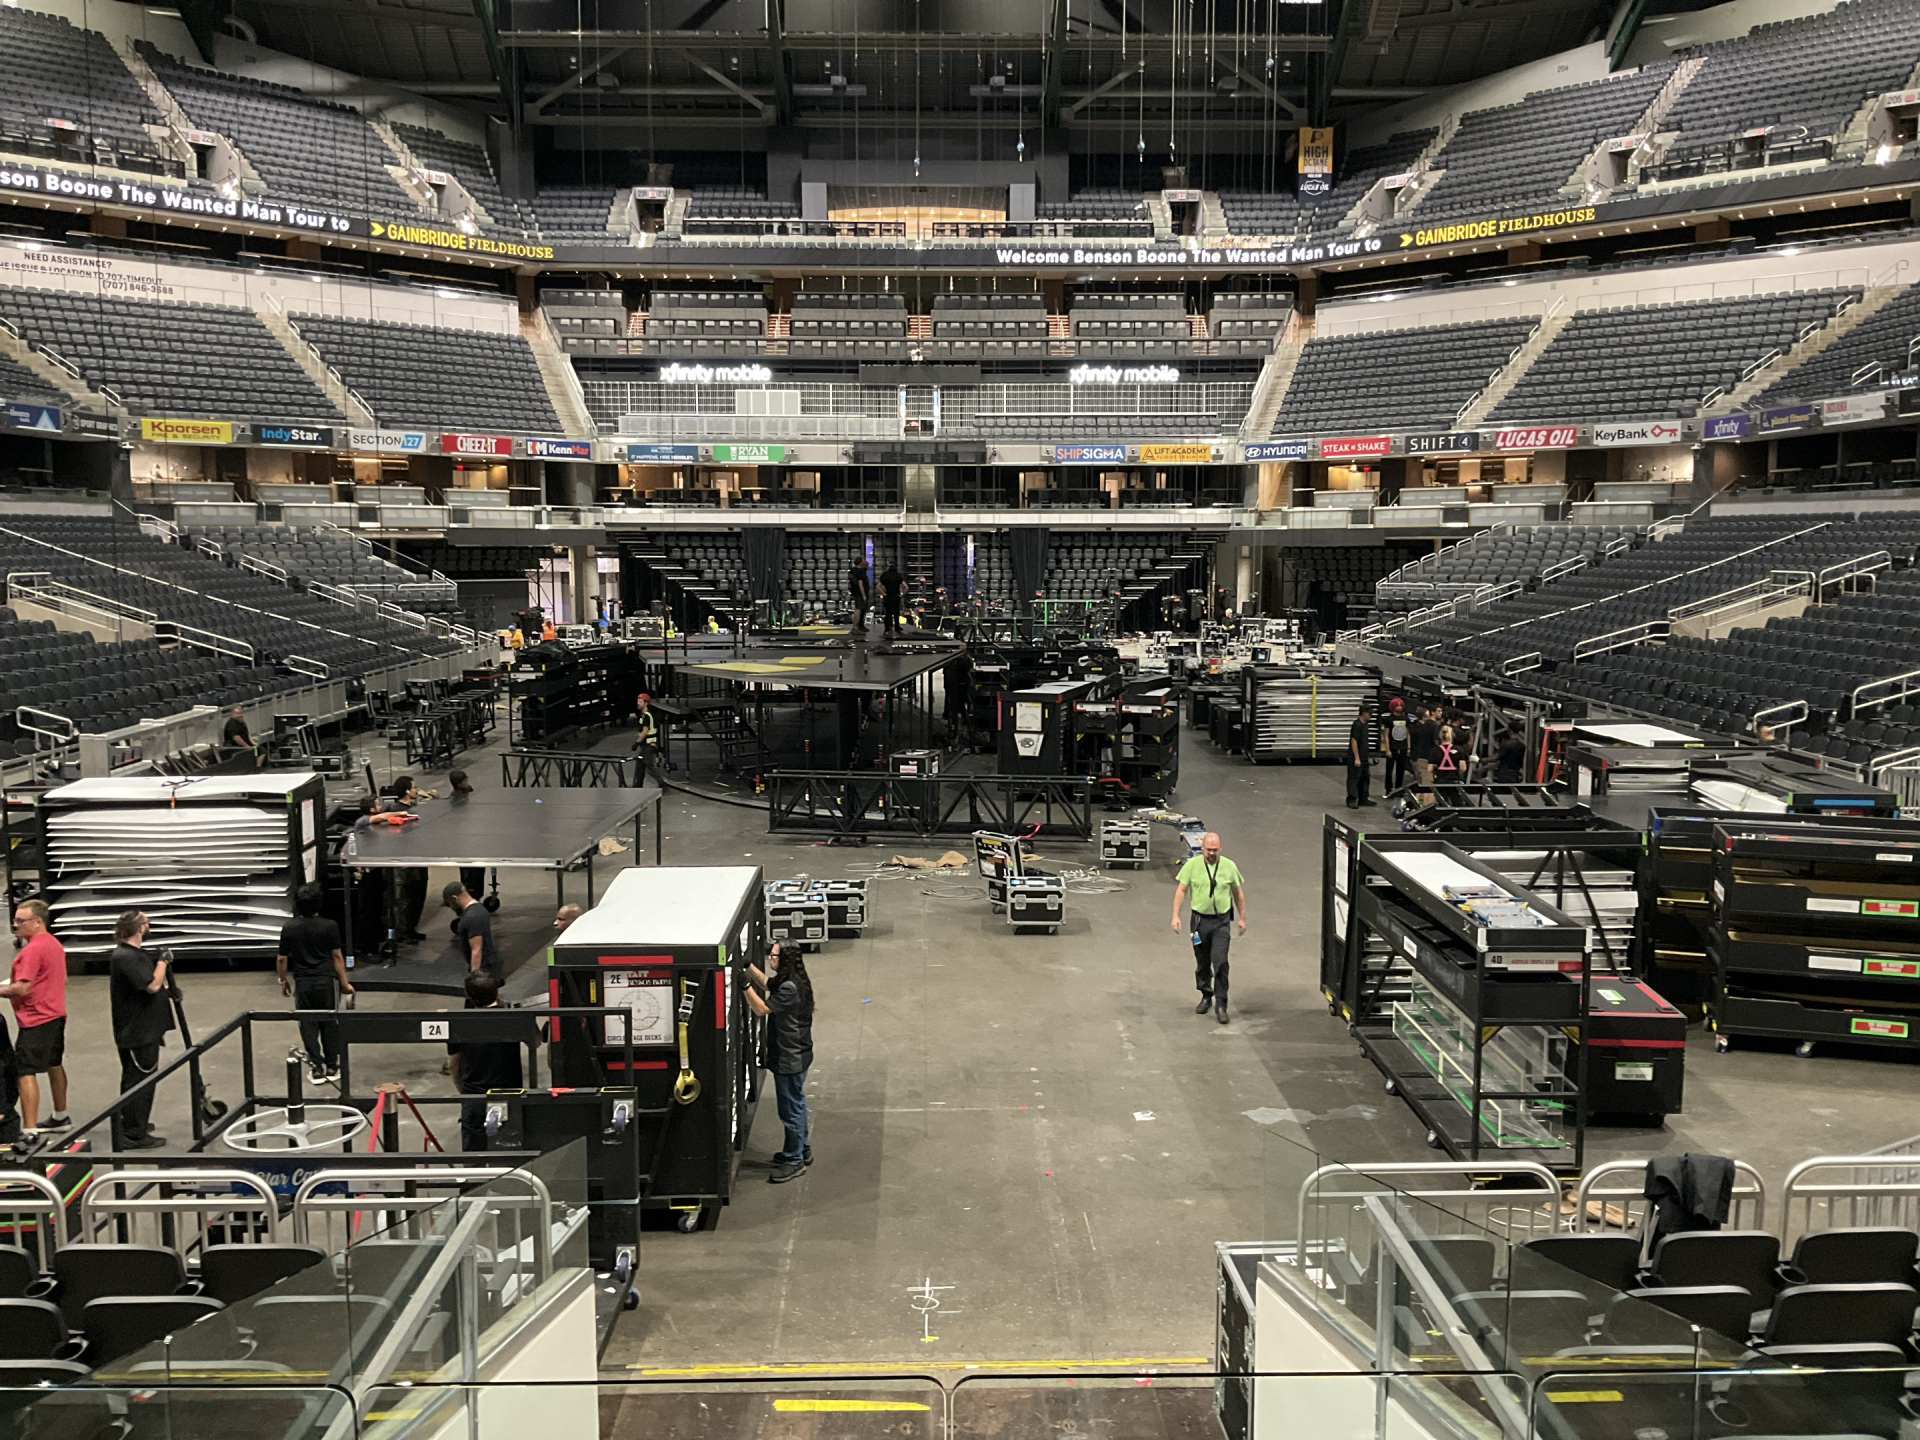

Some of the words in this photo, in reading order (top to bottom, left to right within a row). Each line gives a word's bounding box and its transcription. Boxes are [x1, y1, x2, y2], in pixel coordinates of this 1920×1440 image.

[1304, 146, 1329, 158] HIGH
[1610, 141, 1623, 150] 204
[1304, 159, 1328, 167] OCTANE
[46, 175, 113, 199] Boone
[119, 185, 156, 205] The
[162, 190, 237, 216] Wanted
[242, 202, 281, 222] Man
[286, 209, 326, 228] Tour
[331, 217, 350, 232] to
[1415, 219, 1497, 246] GAINBRIDGE
[1498, 208, 1596, 233] FIELDHOUSE
[387, 223, 467, 250] GAINBRIDGE
[468, 237, 554, 259] FIELDHOUSE
[996, 249, 1069, 264] Welcome
[1073, 249, 1132, 264] Benson
[1137, 249, 1187, 264] Boone
[1192, 250, 1221, 263] The
[1226, 249, 1287, 263] Wanted
[1291, 247, 1323, 263] Man
[1327, 241, 1359, 257] Tour
[1364, 239, 1382, 251] to
[24, 251, 49, 263] NEED
[50, 255, 113, 269] ASSISTANCE?
[102, 279, 128, 292] (707)
[660, 362, 715, 384] xfinity
[715, 363, 772, 381] mobile
[1070, 363, 1123, 385] xfinity
[1123, 364, 1180, 382] mobile
[151, 421, 221, 435] Koorsen
[1713, 419, 1740, 436] xfinity
[1496, 431, 1546, 447] LUCAS
[1549, 429, 1575, 445] OIL
[1595, 428, 1648, 442] KeyBank
[548, 442, 589, 455] KennMar
[1263, 445, 1307, 455] HYUNDAI
[1323, 443, 1350, 453] STEAK
[1357, 441, 1386, 451] SHAKE
[1410, 436, 1457, 450] SHIFT
[1459, 436, 1470, 446] 4
[738, 446, 768, 456] RYAN
[1491, 955, 1503, 964] 4D
[610, 974, 621, 984] 2E
[428, 1025, 442, 1036] 2A
